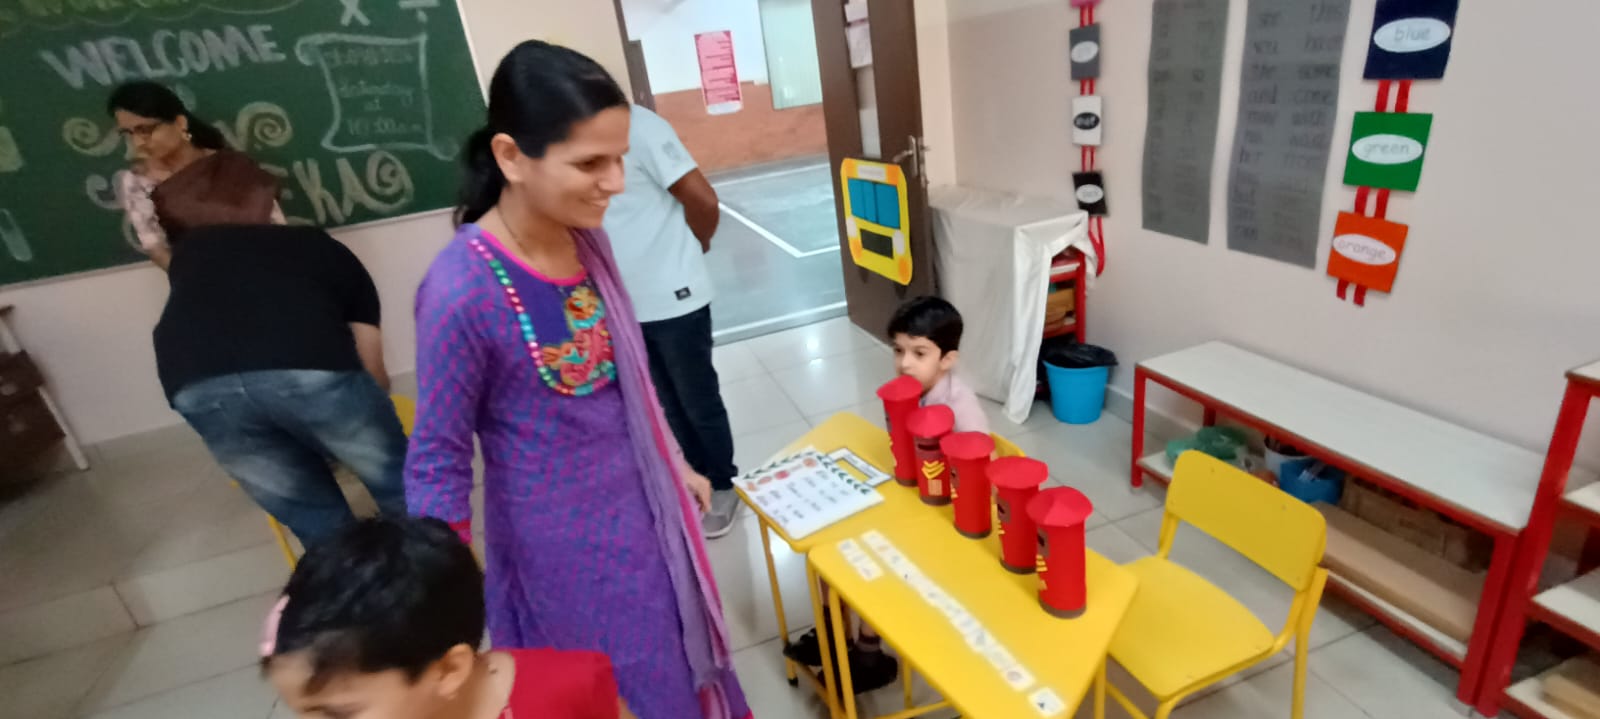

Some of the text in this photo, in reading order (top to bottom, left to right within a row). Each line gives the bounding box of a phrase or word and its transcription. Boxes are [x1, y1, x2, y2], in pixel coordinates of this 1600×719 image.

[1393, 25, 1431, 42] blue
[37, 24, 286, 90] WELCOME
[1363, 141, 1411, 160] green
[1337, 237, 1387, 261] orange
